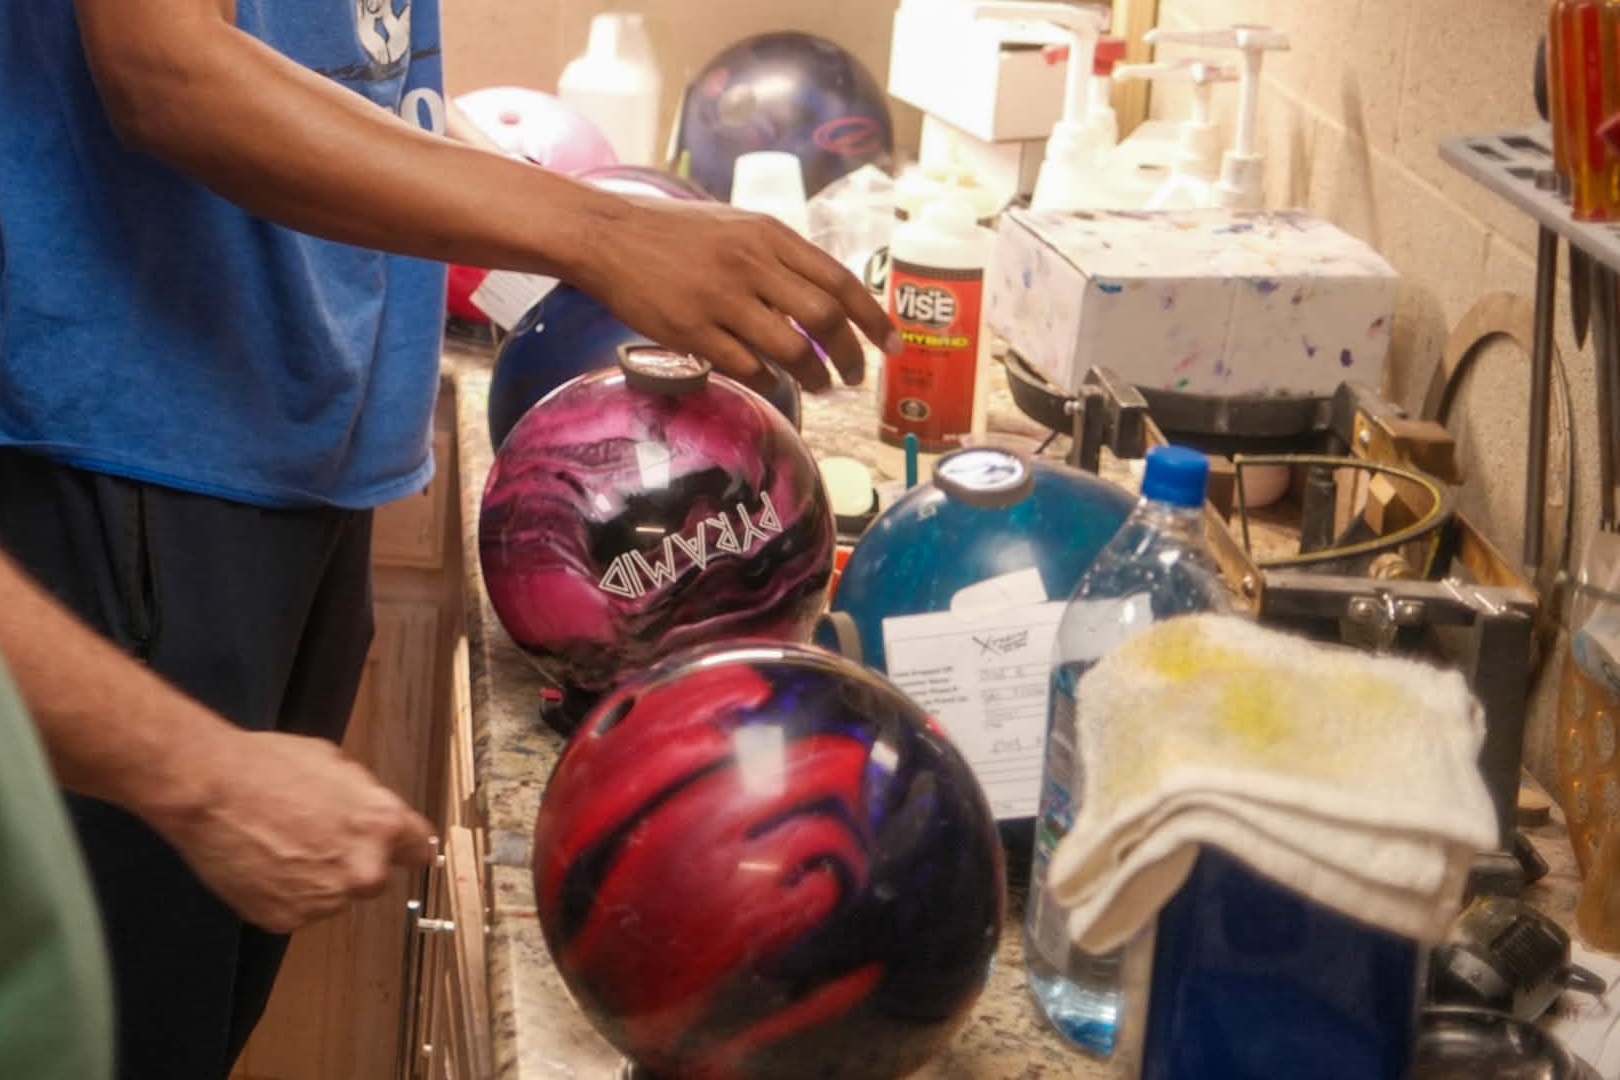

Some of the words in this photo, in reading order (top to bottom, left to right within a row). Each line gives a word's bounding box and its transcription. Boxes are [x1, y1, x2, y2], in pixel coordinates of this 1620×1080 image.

[894, 283, 957, 325] VISE
[900, 331, 970, 349] HYBRID
[598, 490, 783, 600] PYRAMID
